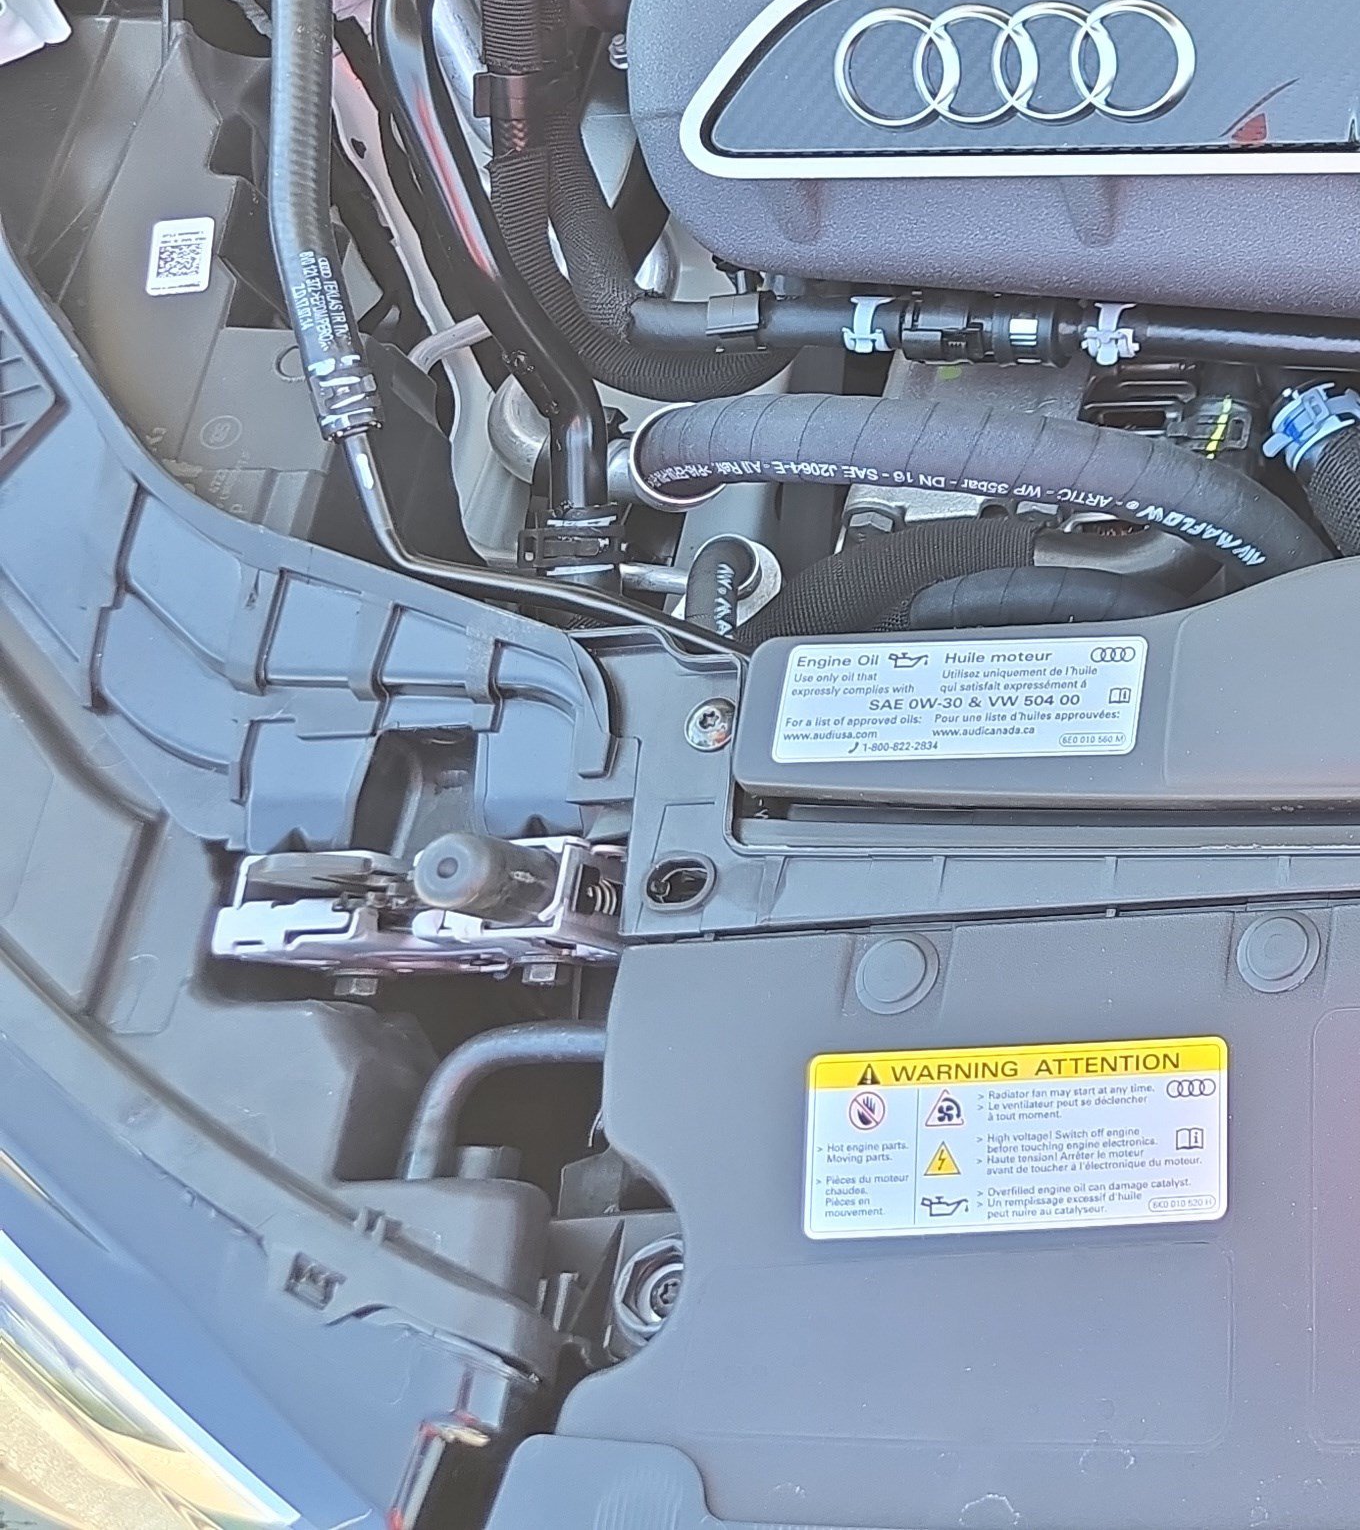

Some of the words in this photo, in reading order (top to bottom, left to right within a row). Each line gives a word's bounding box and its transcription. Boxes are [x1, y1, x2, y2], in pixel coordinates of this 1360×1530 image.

[843, 464, 878, 480] SAE
[919, 475, 946, 488] DN
[964, 479, 1010, 495] 35bar
[1014, 484, 1042, 499] WP
[797, 656, 851, 669] Engine
[857, 654, 879, 666] Oil
[944, 652, 985, 664] Huile
[990, 651, 1052, 663] moteur
[794, 673, 814, 683] Use
[816, 672, 839, 683] only
[841, 672, 855, 681] oil
[857, 672, 877, 681] that
[942, 669, 980, 679] Utilisez
[983, 668, 1046, 679] uniquement
[1049, 666, 1063, 676] de
[791, 686, 840, 697] expressly
[842, 684, 890, 696] complies
[892, 684, 915, 694] with
[940, 682, 957, 693] qui
[960, 680, 1001, 691] satisfait
[1003, 680, 1078, 692] expressément
[868, 698, 904, 711] SAE
[908, 697, 963, 710] 0W-30
[968, 696, 982, 708] &
[988, 695, 1020, 708] VW
[1023, 694, 1054, 707] 504
[1059, 694, 1081, 706] 00
[785, 717, 804, 727] For
[814, 716, 831, 726] list
[833, 716, 846, 726] of
[847, 715, 898, 727] approved
[899, 715, 923, 725] oils:
[934, 713, 960, 723] Pour
[962, 713, 982, 722] une
[984, 712, 1007, 722] liste
[1054, 710, 1121, 721] approuvées:
[783, 730, 878, 740] www.audiusa.com
[932, 725, 1035, 737] www.audicanada.ca
[862, 740, 939, 752] 1-800-822-2834
[891, 1060, 1019, 1082] WARNING
[1034, 1052, 1180, 1076] ATTENTION
[988, 1089, 1030, 1100] Radiator
[1031, 1089, 1048, 1099] fan
[1050, 1088, 1071, 1099] may
[1073, 1087, 1096, 1097] start
[1097, 1086, 1108, 1096] at
[1109, 1086, 1129, 1096] any
[1130, 1084, 1155, 1093] time.
[988, 1101, 1000, 1111] Le
[1001, 1100, 1054, 1110] ventilateur
[1056, 1098, 1079, 1109] peut
[1080, 1099, 1092, 1107] se
[1094, 1095, 1148, 1106] déclencher
[996, 1111, 1016, 1121] tout
[1018, 1109, 1062, 1120] moment.
[987, 1132, 1011, 1144] High
[1012, 1131, 1053, 1142] voltage!
[1055, 1129, 1088, 1140] Switch
[1090, 1128, 1104, 1138] off
[1106, 1127, 1140, 1138] engine
[827, 1143, 844, 1153] Hot
[846, 1142, 880, 1154] engine
[881, 1141, 910, 1152] parts.
[987, 1143, 1019, 1154] before
[1020, 1141, 1064, 1152] touching
[1066, 1140, 1100, 1151] engine
[1102, 1137, 1159, 1148] electronics.
[826, 1153, 864, 1165] Moving
[865, 1153, 893, 1163] parts.
[987, 1154, 1016, 1165] Haute
[1017, 1152, 1058, 1163] tension!
[1096, 1150, 1106, 1159] le
[1108, 1149, 1145, 1159] moteur
[986, 1165, 1014, 1176] avant
[1016, 1164, 1029, 1174] de
[1030, 1162, 1068, 1173] toucher
[1148, 1158, 1162, 1168] du
[1164, 1156, 1203, 1167] moteur.
[825, 1175, 857, 1186] Pièces
[858, 1175, 872, 1184] du
[874, 1174, 910, 1183] moteur
[825, 1185, 869, 1196] chaudes.
[987, 1186, 1035, 1198] Overfilled
[1037, 1185, 1071, 1196] engine
[1073, 1183, 1086, 1193] oil
[1088, 1183, 1107, 1192] can
[1107, 1180, 1149, 1191] damage
[1150, 1177, 1191, 1189] catalyst.
[825, 1197, 856, 1207] Pièces
[858, 1198, 871, 1206] en
[987, 1197, 1001, 1208] Un
[1004, 1194, 1065, 1208] remplissage
[1066, 1191, 1106, 1204] excessif
[1107, 1190, 1142, 1202] d'huile
[824, 1207, 885, 1218] mouvement.
[987, 1210, 1010, 1220] peut
[1011, 1208, 1038, 1218] nuire
[1039, 1207, 1052, 1216] au
[1054, 1204, 1108, 1216] catalyseur.
